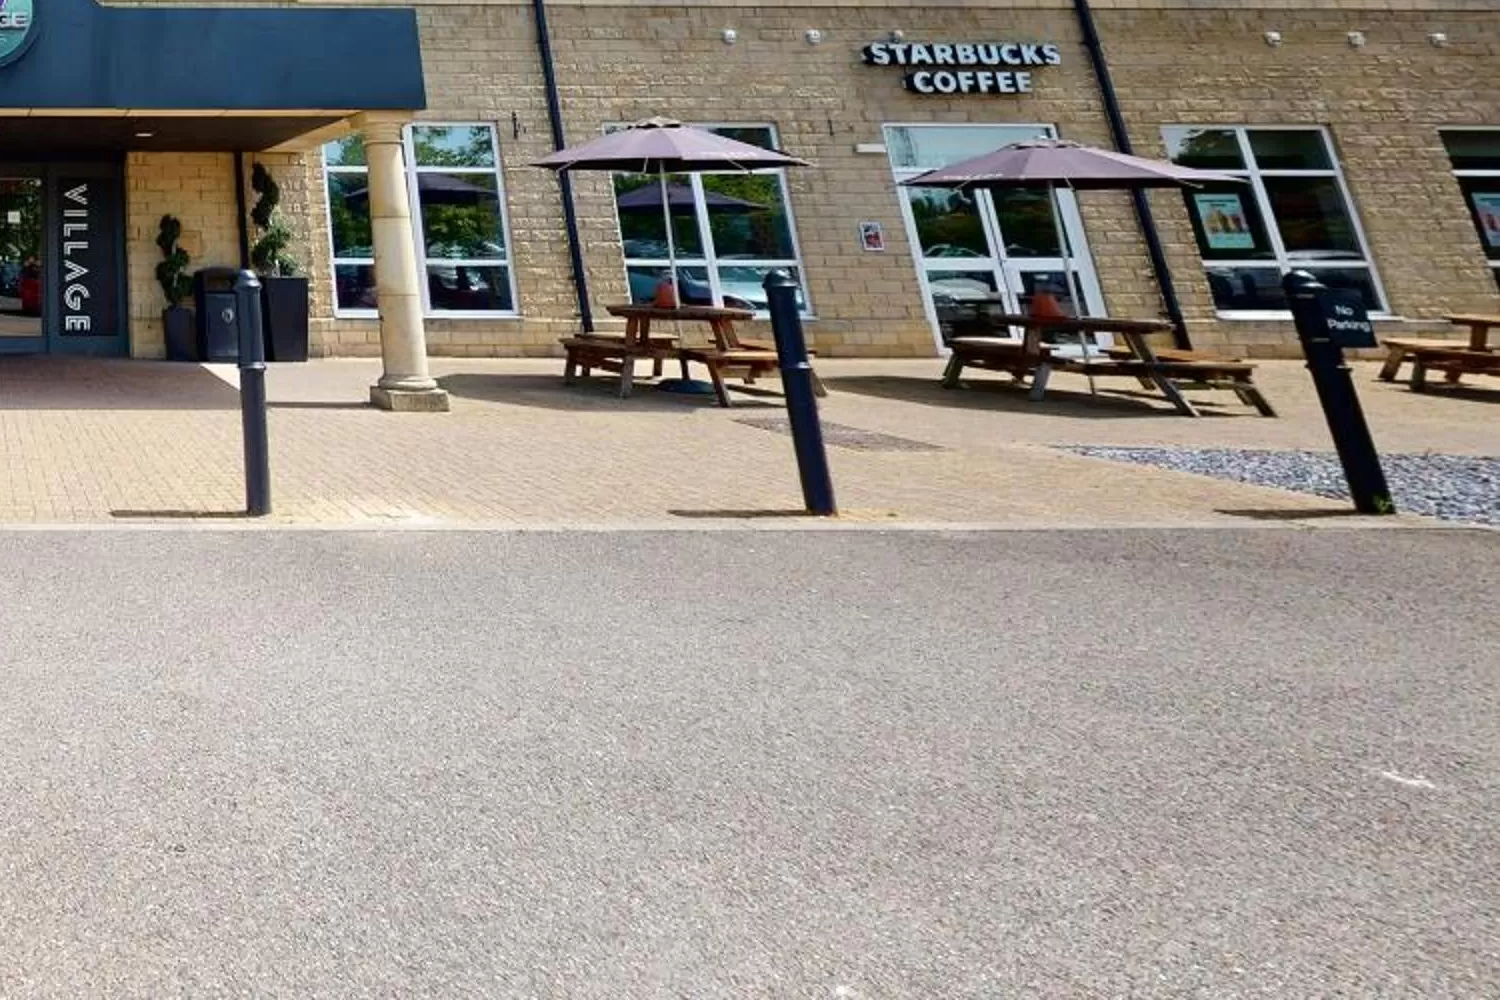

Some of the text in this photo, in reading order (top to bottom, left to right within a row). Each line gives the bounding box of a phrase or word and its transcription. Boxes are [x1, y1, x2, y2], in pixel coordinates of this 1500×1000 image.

[869, 42, 1061, 65] STARBUCKS
[913, 71, 1033, 93] COFFEE
[63, 183, 91, 331] VILLAGE
[1335, 304, 1354, 316] No
[1326, 318, 1371, 332] Parking
